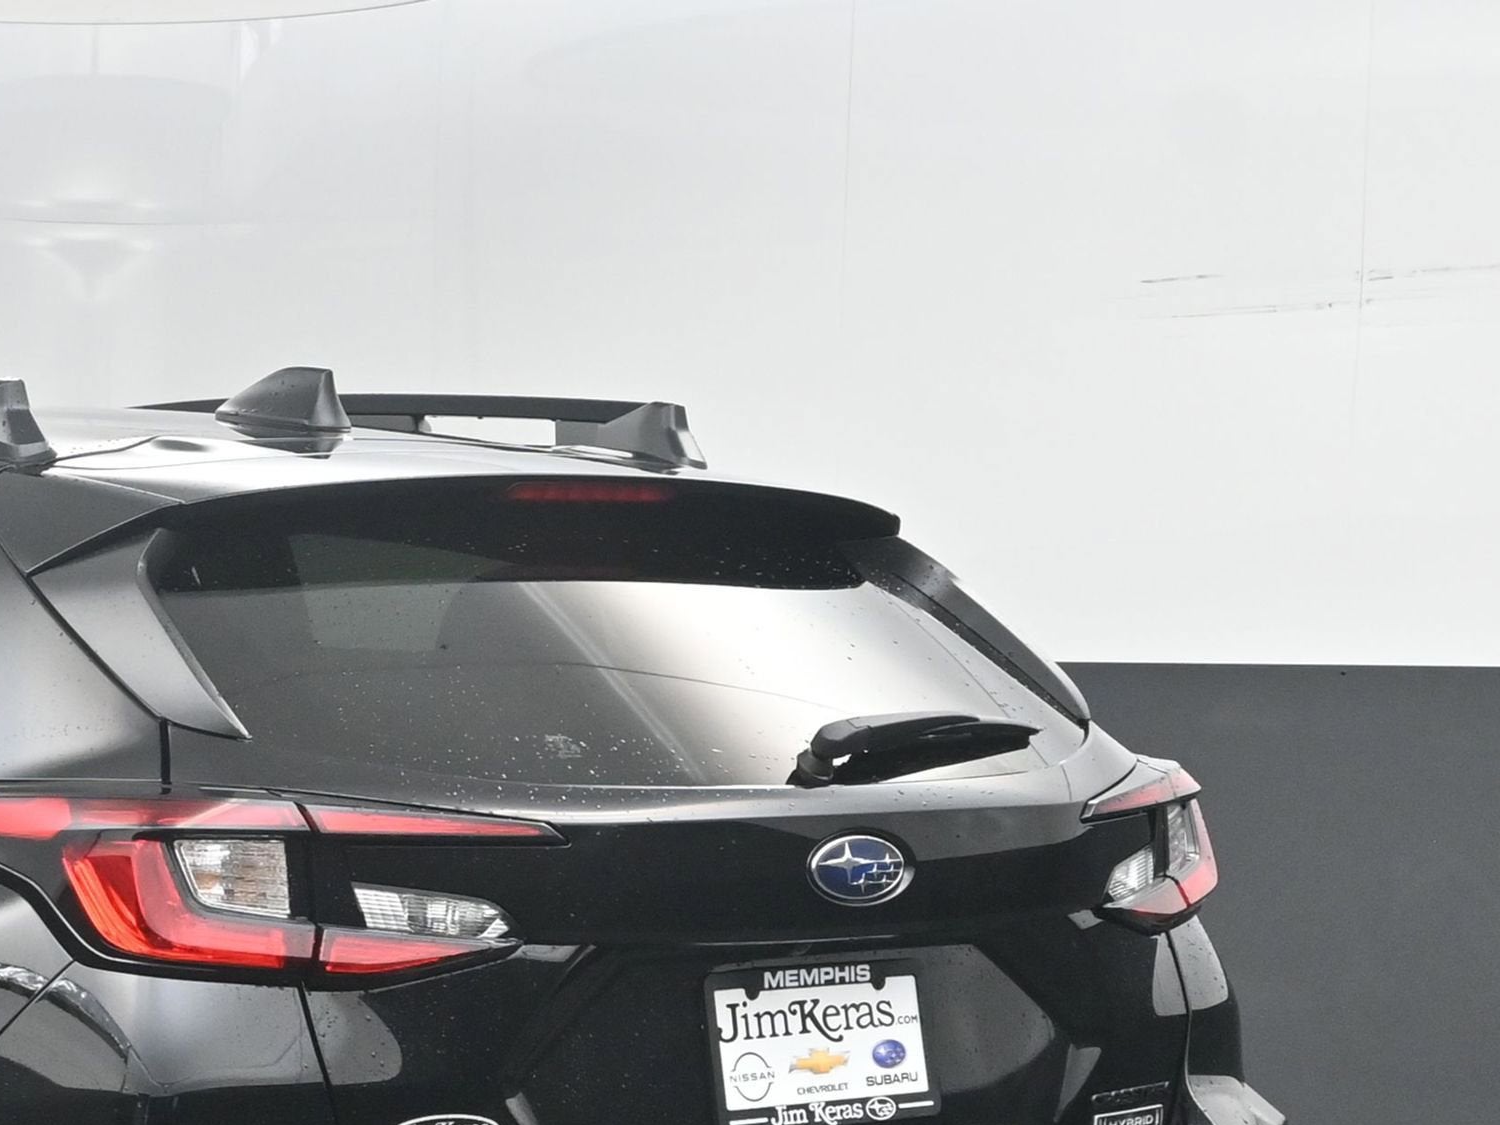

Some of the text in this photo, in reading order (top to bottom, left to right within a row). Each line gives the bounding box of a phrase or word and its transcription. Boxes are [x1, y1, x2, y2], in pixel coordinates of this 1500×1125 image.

[763, 964, 871, 989] MEMPHIS
[729, 1070, 776, 1083] NISSAN
[865, 1071, 919, 1087] SUBARU
[796, 1082, 849, 1096] CHEVROLET
[809, 1100, 864, 1125] Keras
